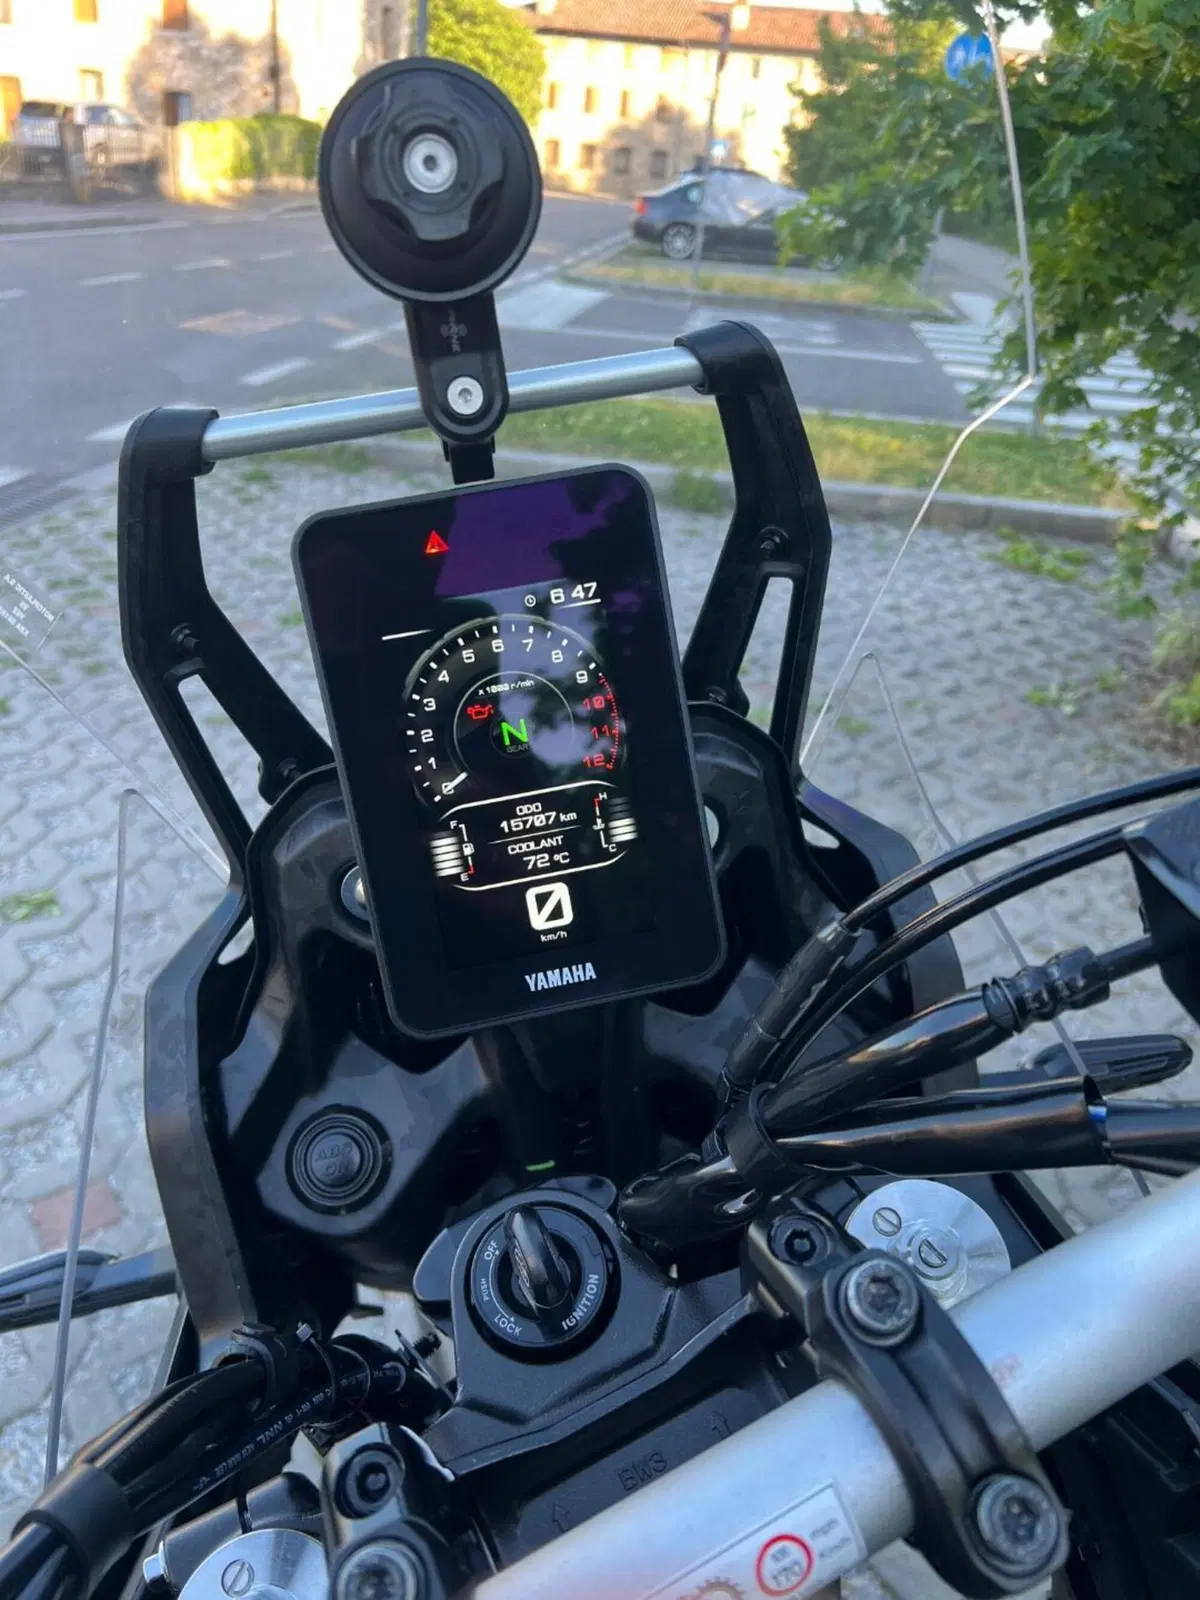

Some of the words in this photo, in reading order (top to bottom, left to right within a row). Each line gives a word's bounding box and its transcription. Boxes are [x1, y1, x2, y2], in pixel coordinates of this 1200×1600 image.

[491, 639, 505, 652] 6
[522, 638, 534, 652] 7
[462, 650, 476, 663] 5
[551, 649, 564, 663] 8
[437, 670, 450, 683] 4
[576, 670, 588, 683] 9
[510, 679, 535, 690] r/min
[423, 698, 436, 711] 3
[582, 695, 605, 710] 10
[420, 729, 434, 742] 2
[501, 718, 529, 746] N
[590, 724, 611, 739] 11
[506, 743, 529, 753] GEAR
[427, 757, 437, 770] 1
[582, 753, 605, 768] 12
[599, 792, 608, 800] H
[516, 802, 542, 816] ODO
[450, 821, 458, 829] F
[499, 811, 557, 833] 15707
[560, 811, 578, 823] km
[507, 835, 564, 855] COOLANT
[608, 844, 617, 853] C
[522, 854, 551, 870] 72
[460, 873, 469, 882] E
[525, 881, 574, 931] 0
[540, 930, 568, 943] km/h
[524, 962, 598, 992] YAMAHA
[484, 1240, 498, 1260] OFF
[480, 1278, 490, 1302] PUSH
[561, 1274, 600, 1331] IGNITION
[494, 1313, 523, 1336] LOCK
